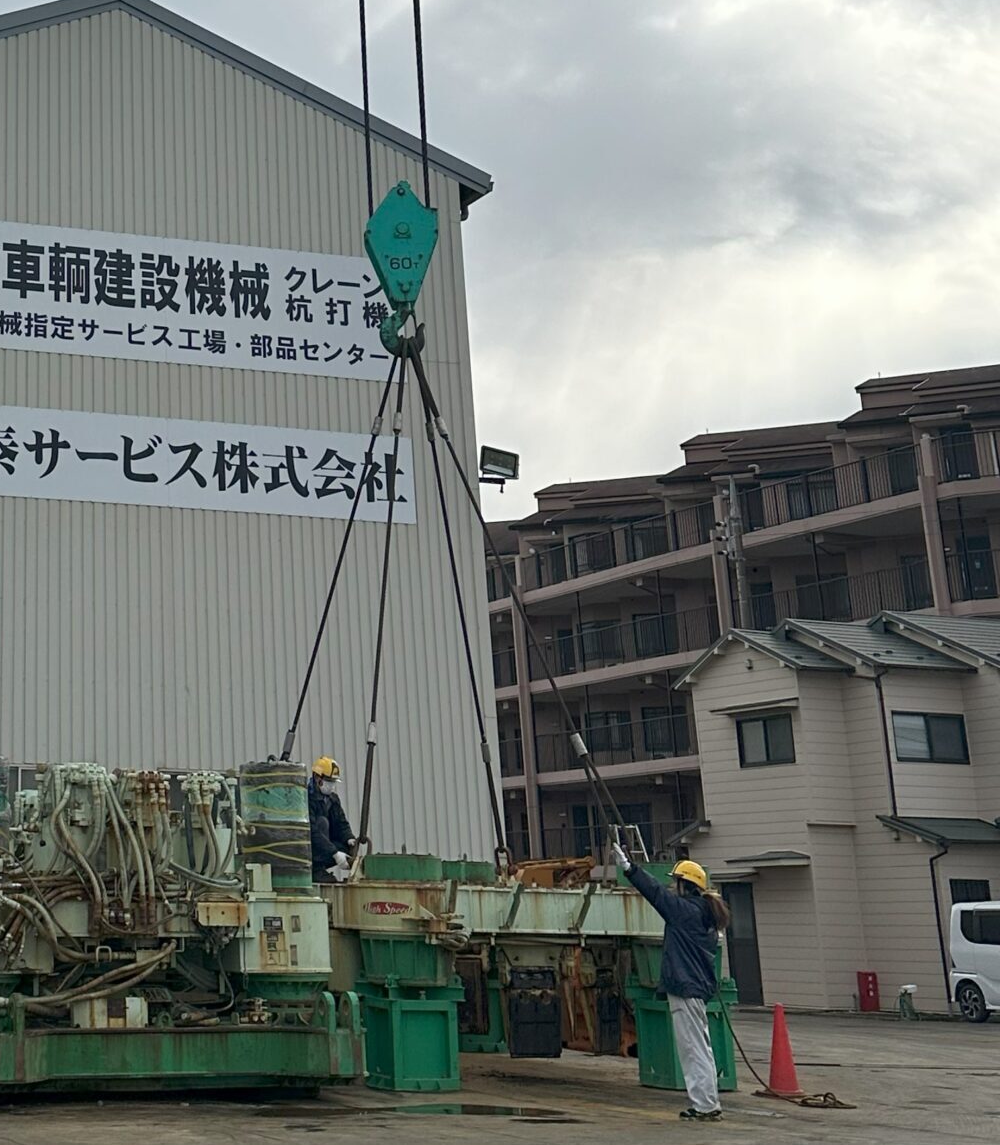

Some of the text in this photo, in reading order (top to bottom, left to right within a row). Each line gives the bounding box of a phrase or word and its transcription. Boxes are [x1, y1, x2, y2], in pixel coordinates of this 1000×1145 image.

[390, 257, 419, 270] 60T
[284, 266, 383, 299] クレーン
[285, 294, 390, 330] 杭打機
